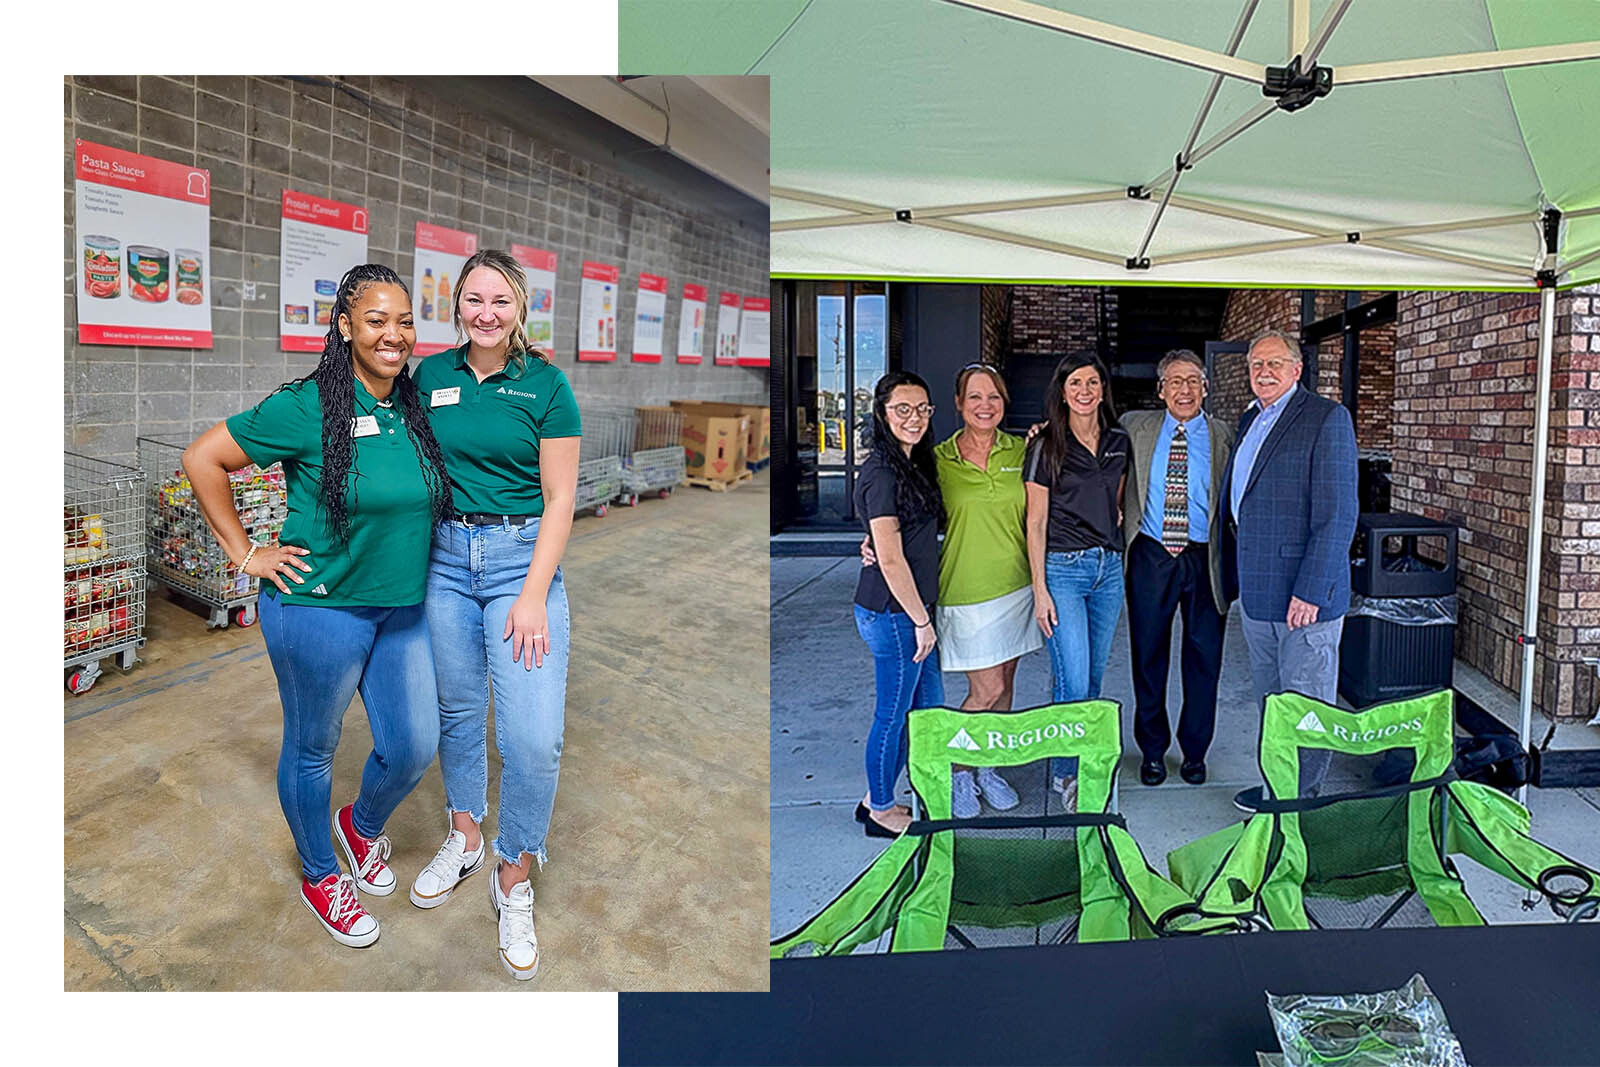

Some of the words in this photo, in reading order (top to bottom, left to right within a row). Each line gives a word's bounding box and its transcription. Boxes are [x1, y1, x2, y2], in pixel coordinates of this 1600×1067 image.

[82, 154, 110, 170] Pasta
[112, 161, 145, 178] Sauces
[92, 274, 113, 282] PASTE
[507, 388, 537, 400] REGIONS
[986, 722, 1086, 750] REGIONS
[1333, 717, 1423, 743] REGIONS
